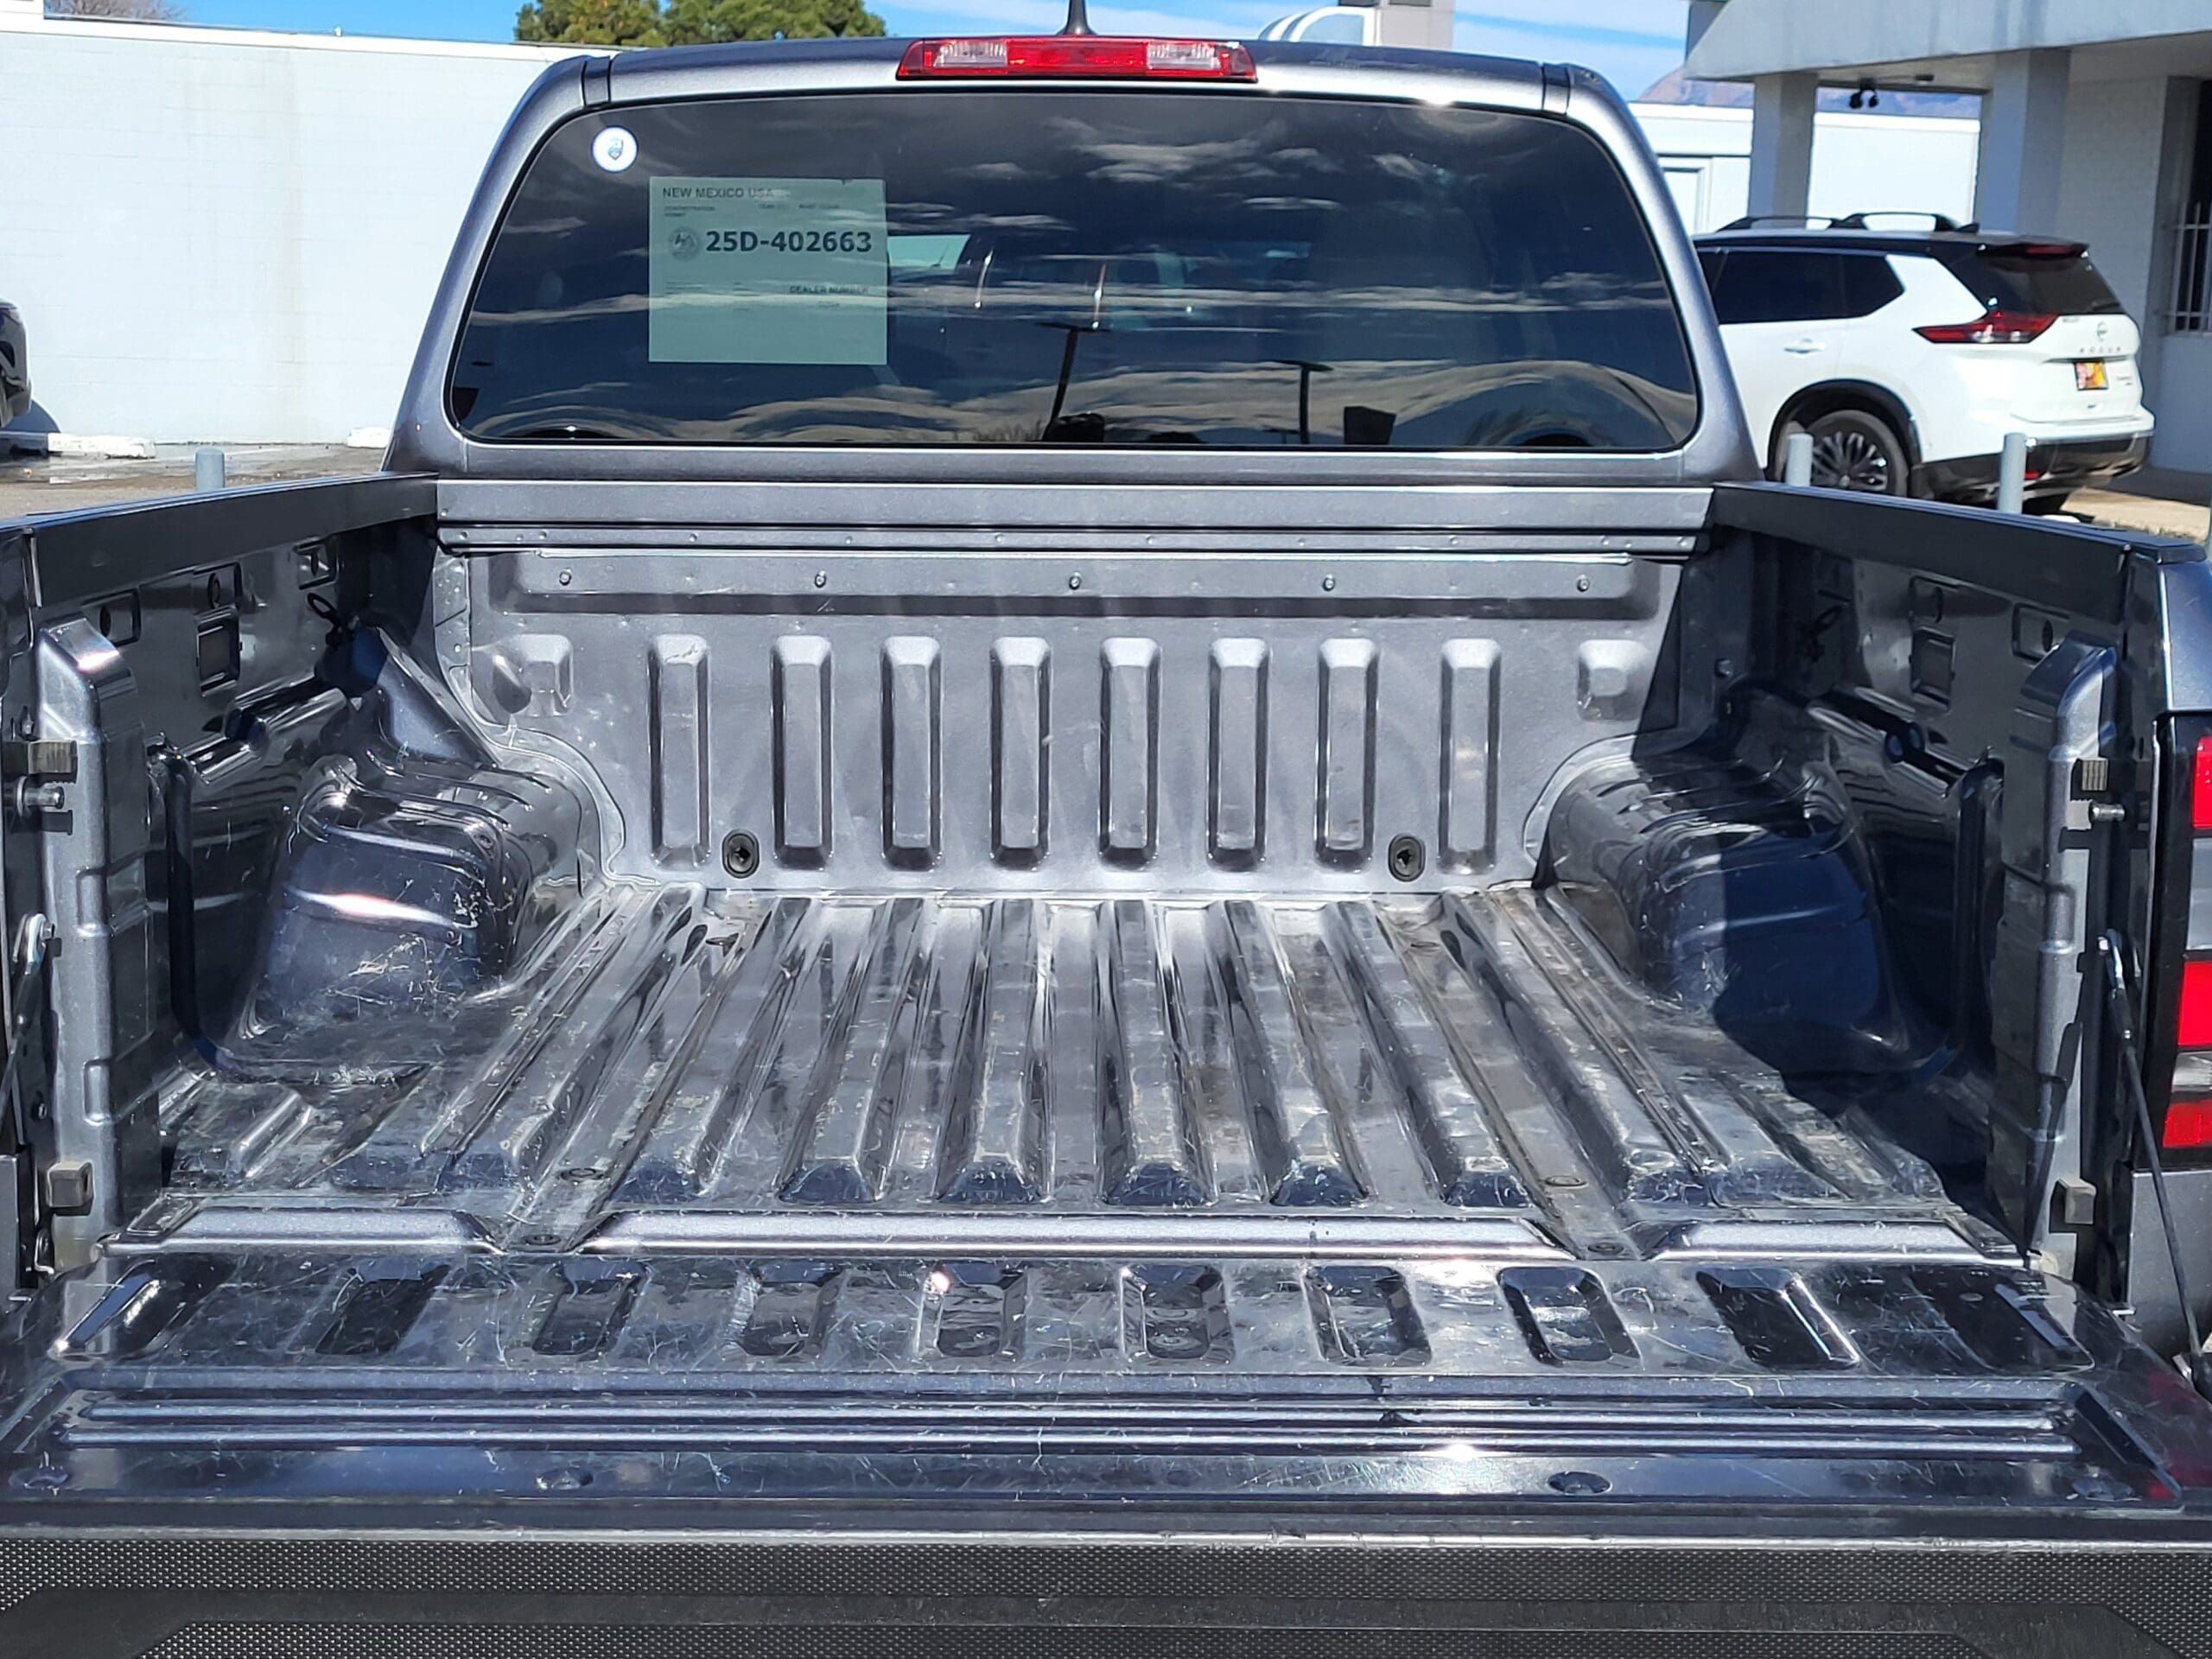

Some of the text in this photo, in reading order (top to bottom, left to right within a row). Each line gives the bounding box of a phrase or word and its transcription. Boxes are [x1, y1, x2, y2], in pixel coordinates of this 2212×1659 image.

[663, 188, 691, 198] NEW
[696, 188, 744, 199] MEXICO
[706, 231, 872, 252] 25D-402663
[790, 285, 826, 295] DEALER
